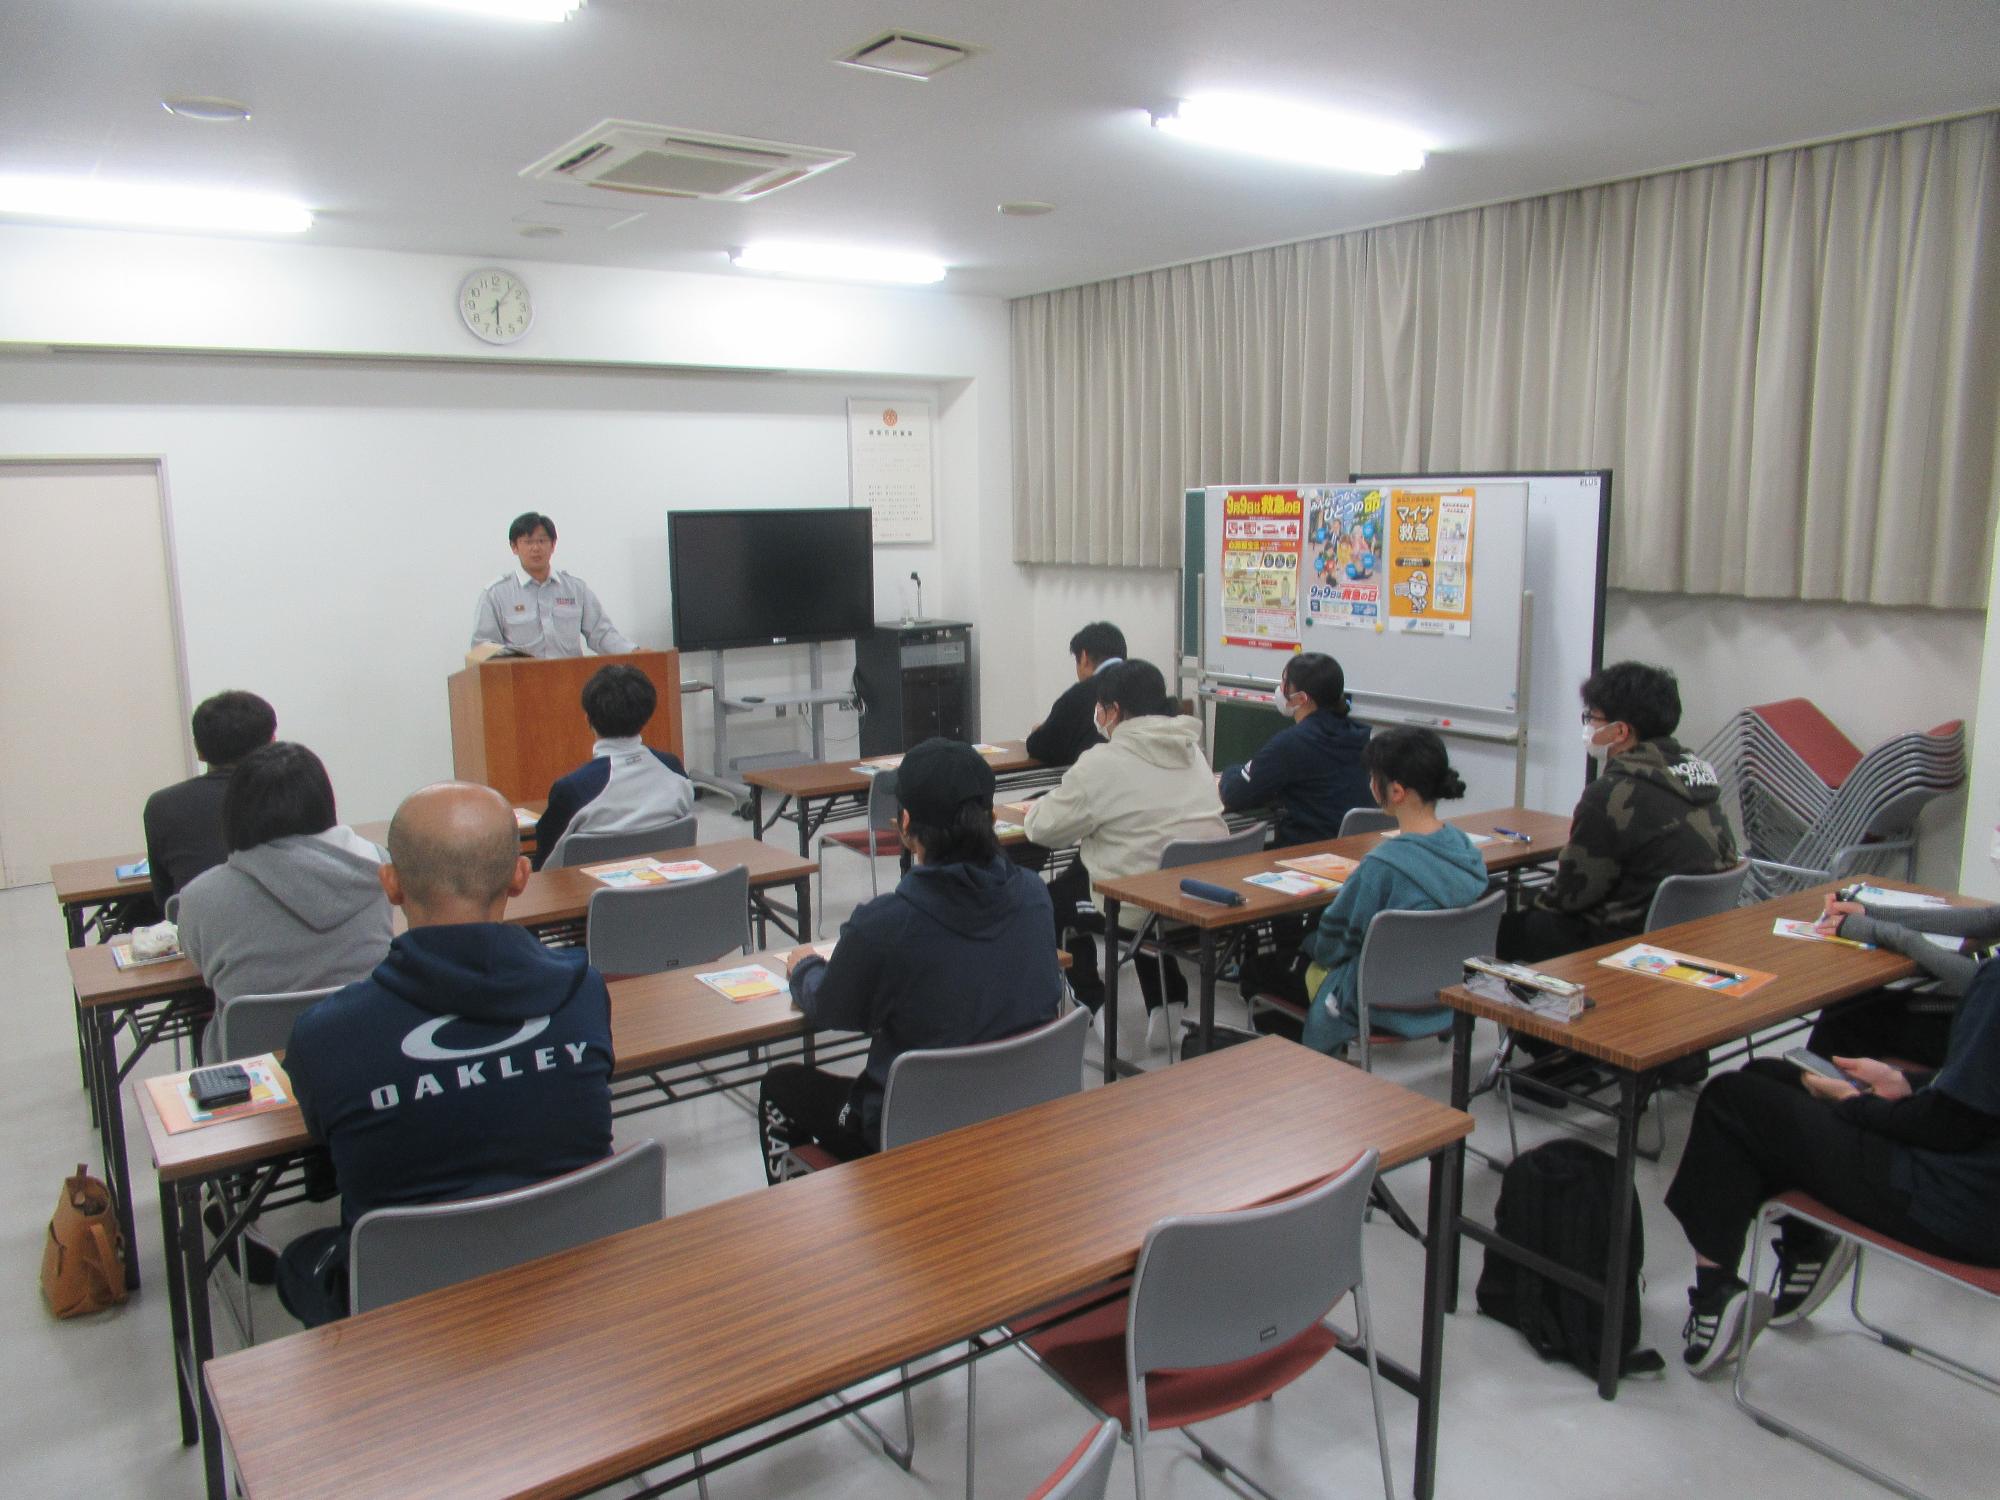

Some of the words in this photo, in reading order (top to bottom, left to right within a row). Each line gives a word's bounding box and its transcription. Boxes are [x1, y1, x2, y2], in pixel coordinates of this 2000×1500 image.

[480, 279, 488, 289] 11
[491, 274, 500, 286] 12
[471, 287, 480, 297] 10
[515, 290, 521, 300] 2
[468, 300, 476, 310] 9
[519, 303, 526, 312] 3
[473, 313, 480, 322] 8
[483, 322, 490, 332] 7
[495, 327, 502, 336] 6
[508, 323, 515, 334] 5
[1580, 478, 1598, 487] PLUS
[1227, 493, 1301, 514] 9月9日は救急の日
[1324, 490, 1381, 521] ひとつの命
[1397, 505, 1433, 522] マイナ
[1399, 522, 1431, 542] 救急
[1310, 585, 1377, 601] 9月9日は救急の日
[371, 1041, 588, 1111] OAKLEY
